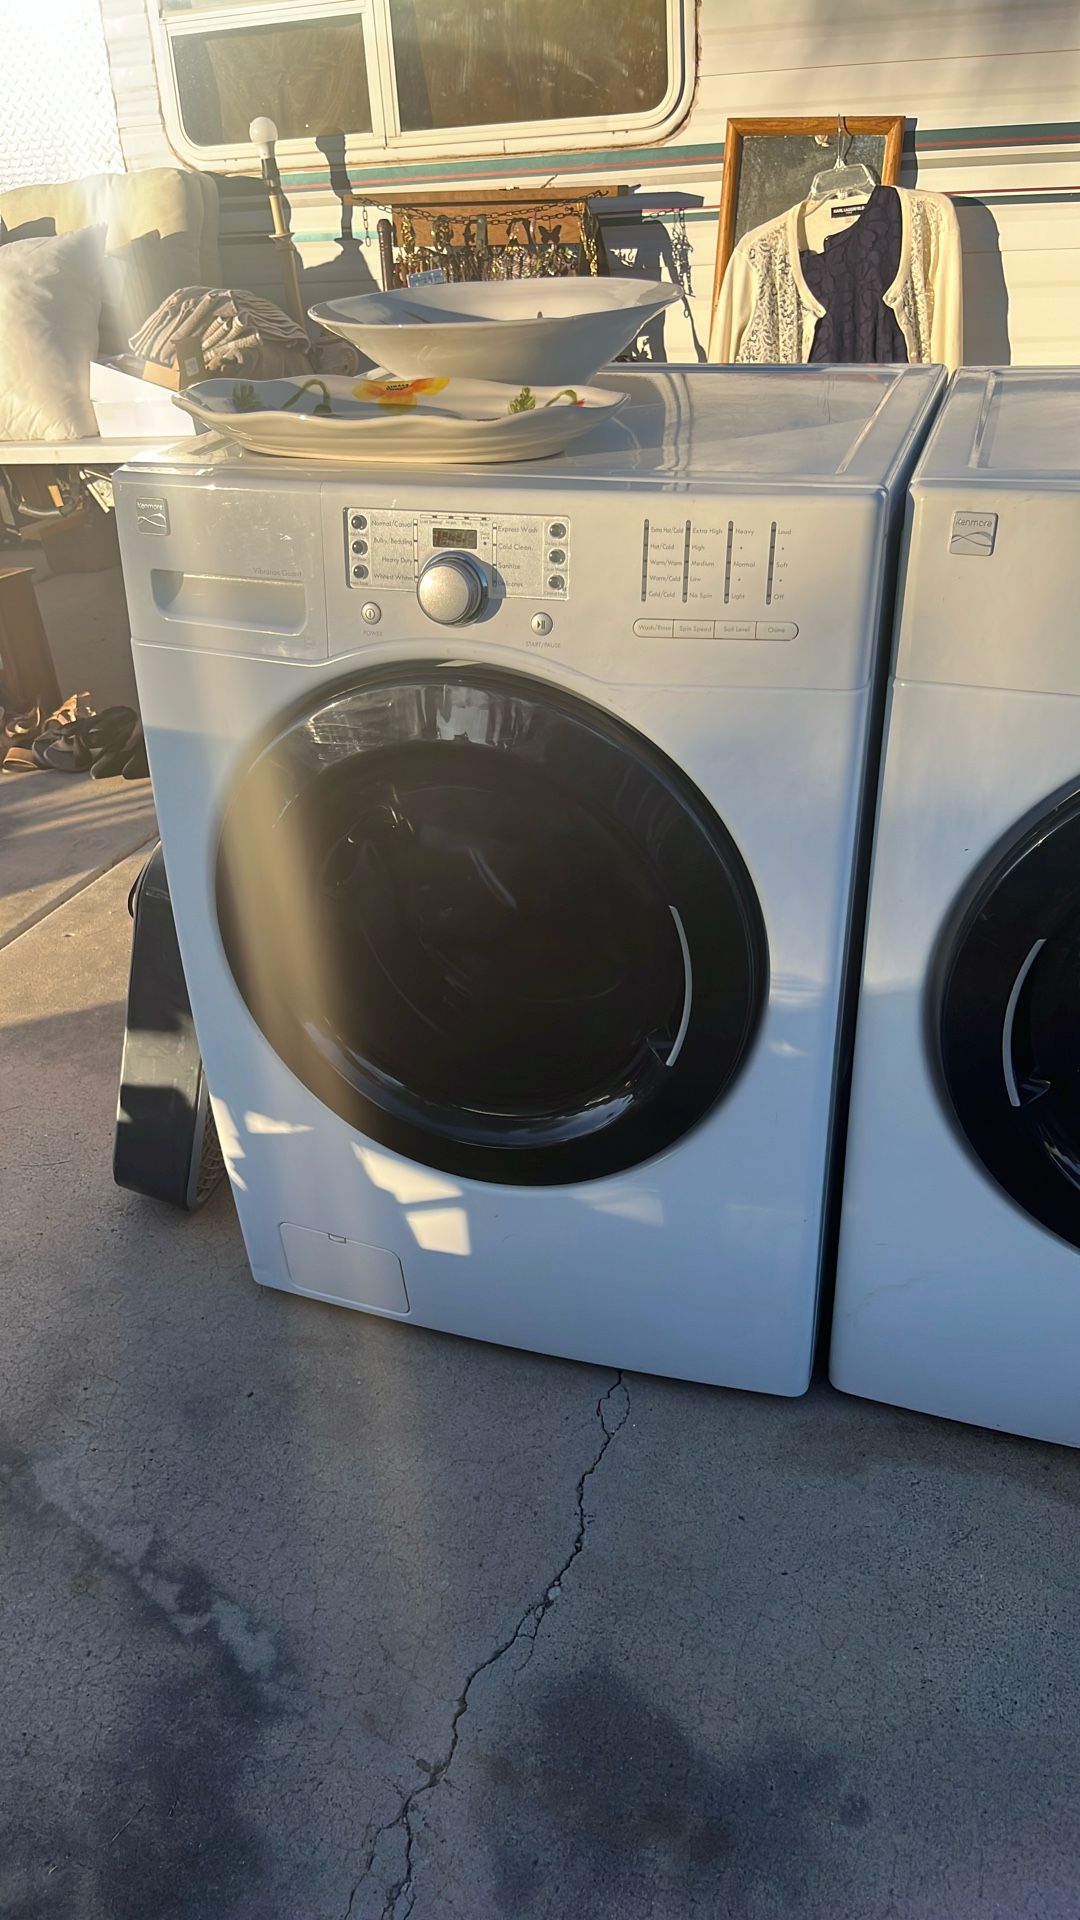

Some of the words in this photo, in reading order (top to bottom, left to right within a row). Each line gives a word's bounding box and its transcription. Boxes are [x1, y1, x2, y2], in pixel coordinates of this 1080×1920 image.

[137, 502, 162, 511] Kenmore
[371, 520, 413, 528] Normal/Casual
[955, 518, 992, 527] Kenmore
[498, 526, 520, 534] Express
[382, 557, 398, 565] Heavy
